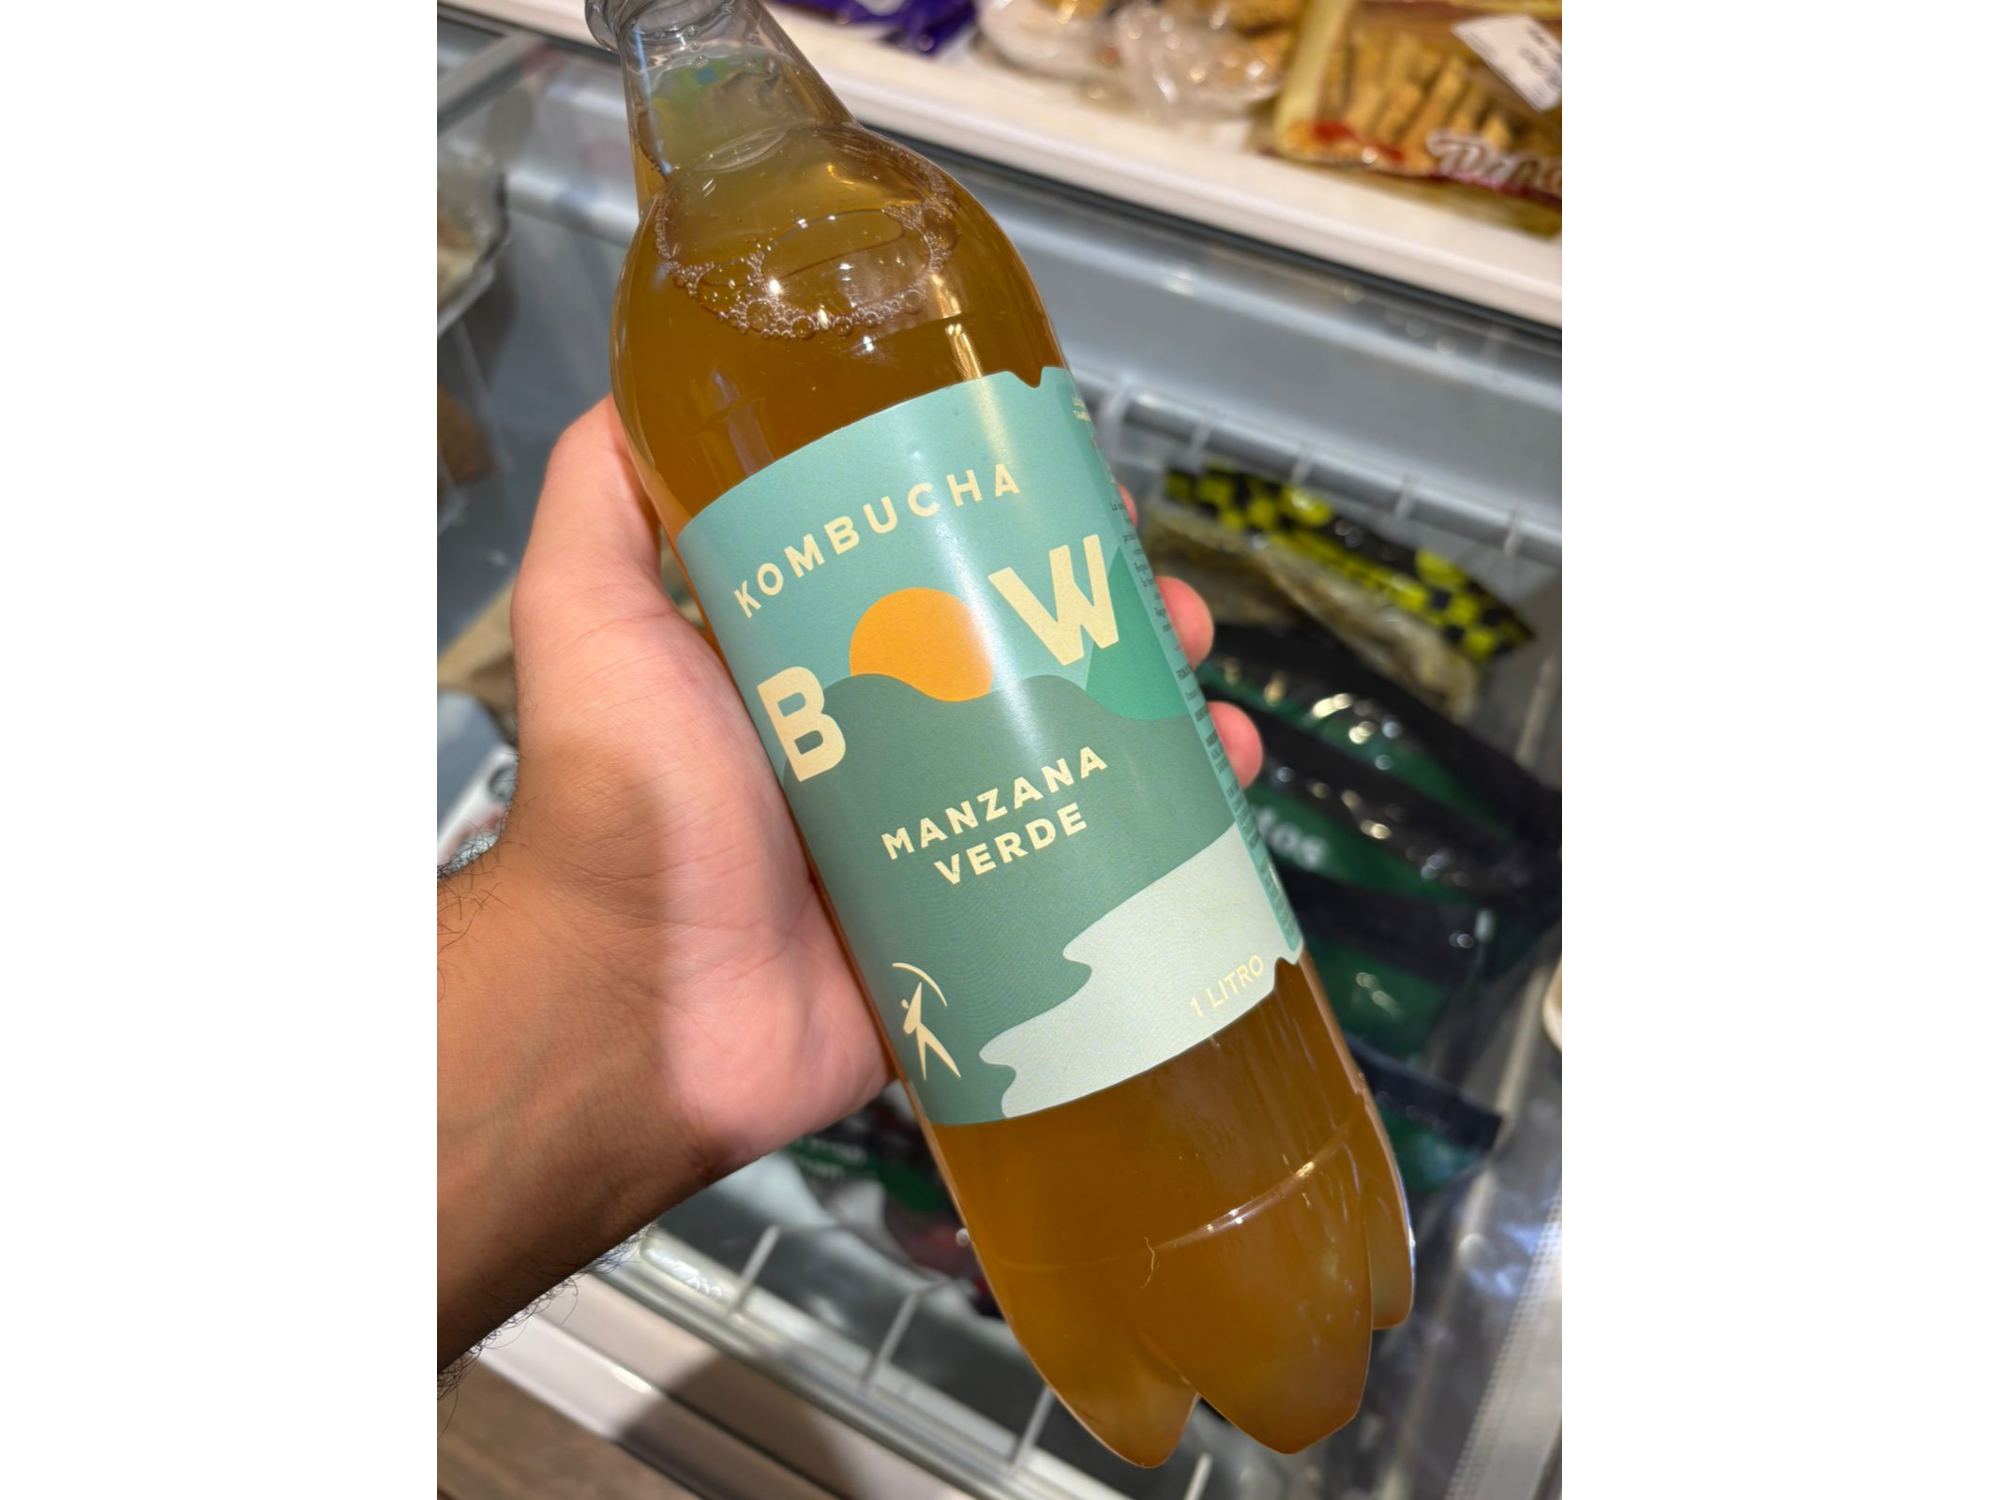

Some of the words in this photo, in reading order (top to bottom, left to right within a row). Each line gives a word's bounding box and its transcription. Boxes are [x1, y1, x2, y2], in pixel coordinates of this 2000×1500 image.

[733, 464, 1020, 618] KOMBUCHA
[881, 746, 1108, 860] MANZANA
[933, 802, 1088, 885] VERDE
[1189, 996, 1203, 1017] 1
[1205, 954, 1263, 1009] LITRO
